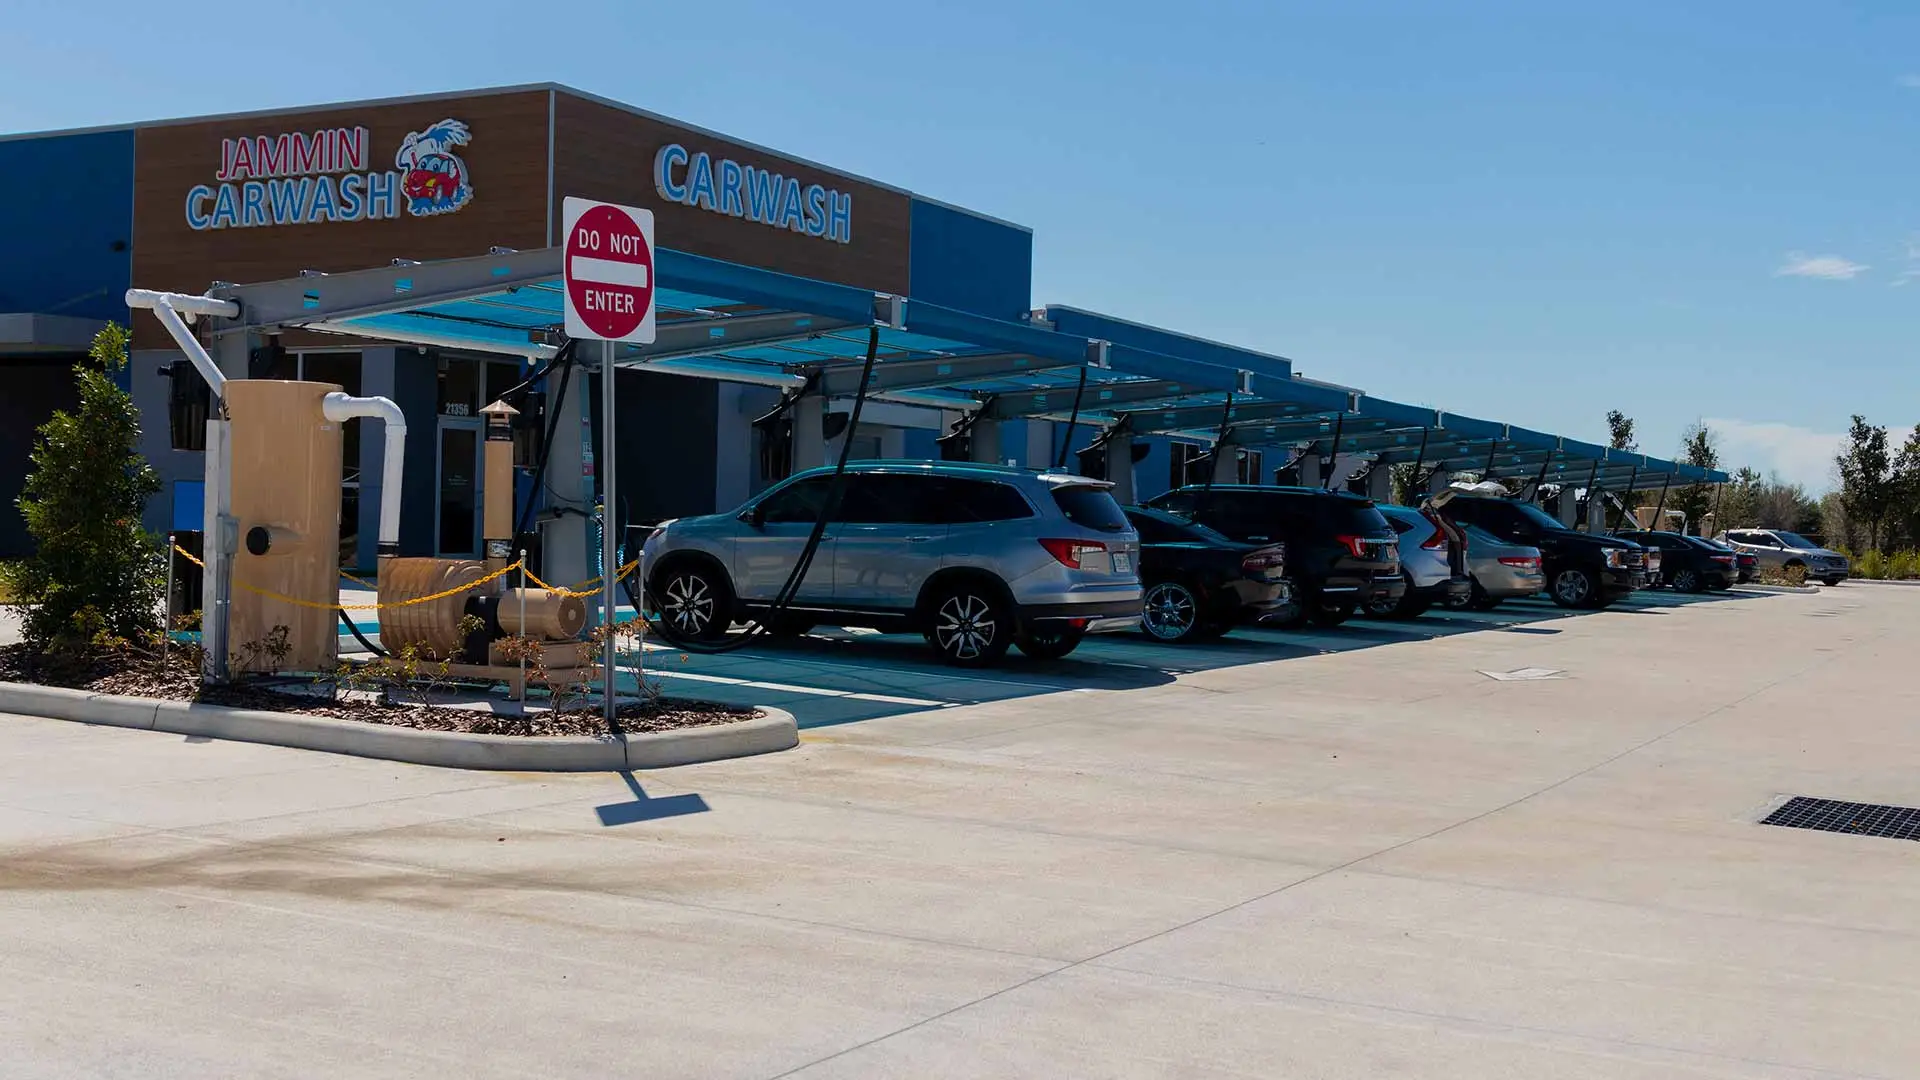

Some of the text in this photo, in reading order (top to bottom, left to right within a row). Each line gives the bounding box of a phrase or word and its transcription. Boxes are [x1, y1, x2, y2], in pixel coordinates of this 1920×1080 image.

[216, 126, 367, 181] JAMMIN
[185, 170, 399, 230] CARWASH
[654, 144, 851, 244] CARWASH
[578, 228, 640, 256] DO NOT
[585, 289, 635, 314] ENTER
[445, 402, 469, 416] 21356
